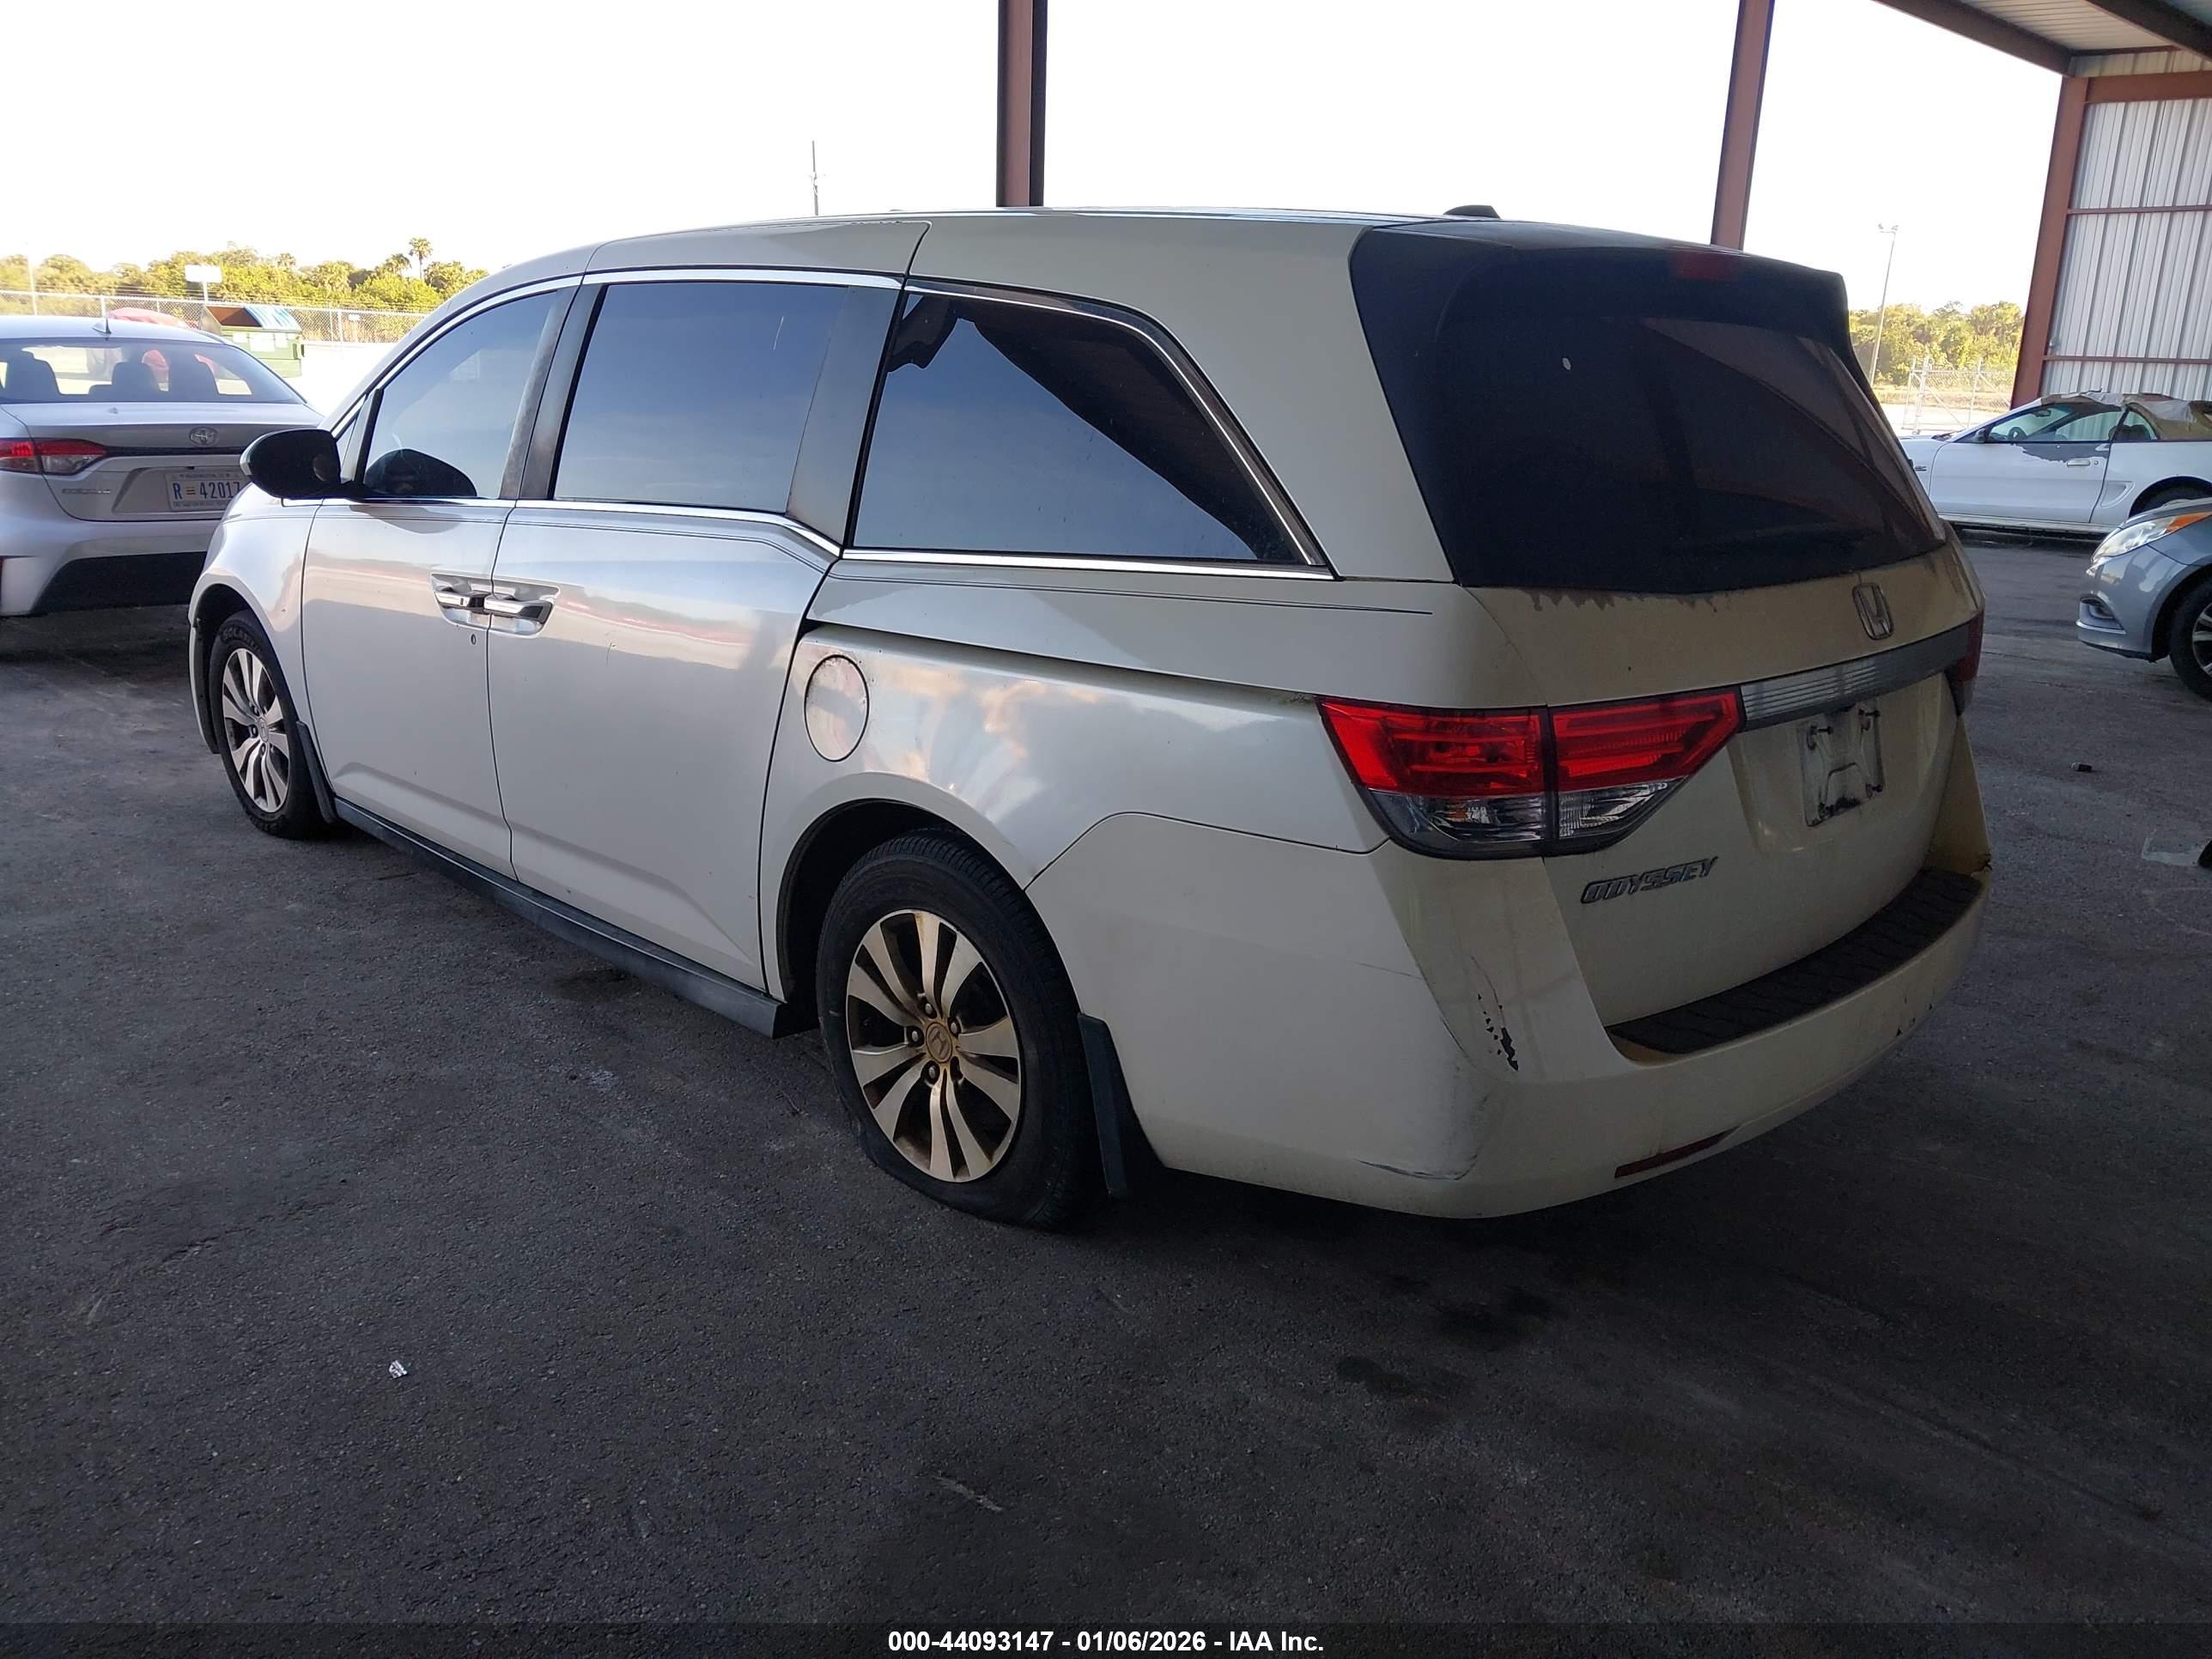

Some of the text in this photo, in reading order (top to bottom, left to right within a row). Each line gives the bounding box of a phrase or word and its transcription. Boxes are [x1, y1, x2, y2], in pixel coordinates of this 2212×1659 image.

[173, 482, 240, 500] R 42017
[1580, 855, 1718, 904] ODYSSEY
